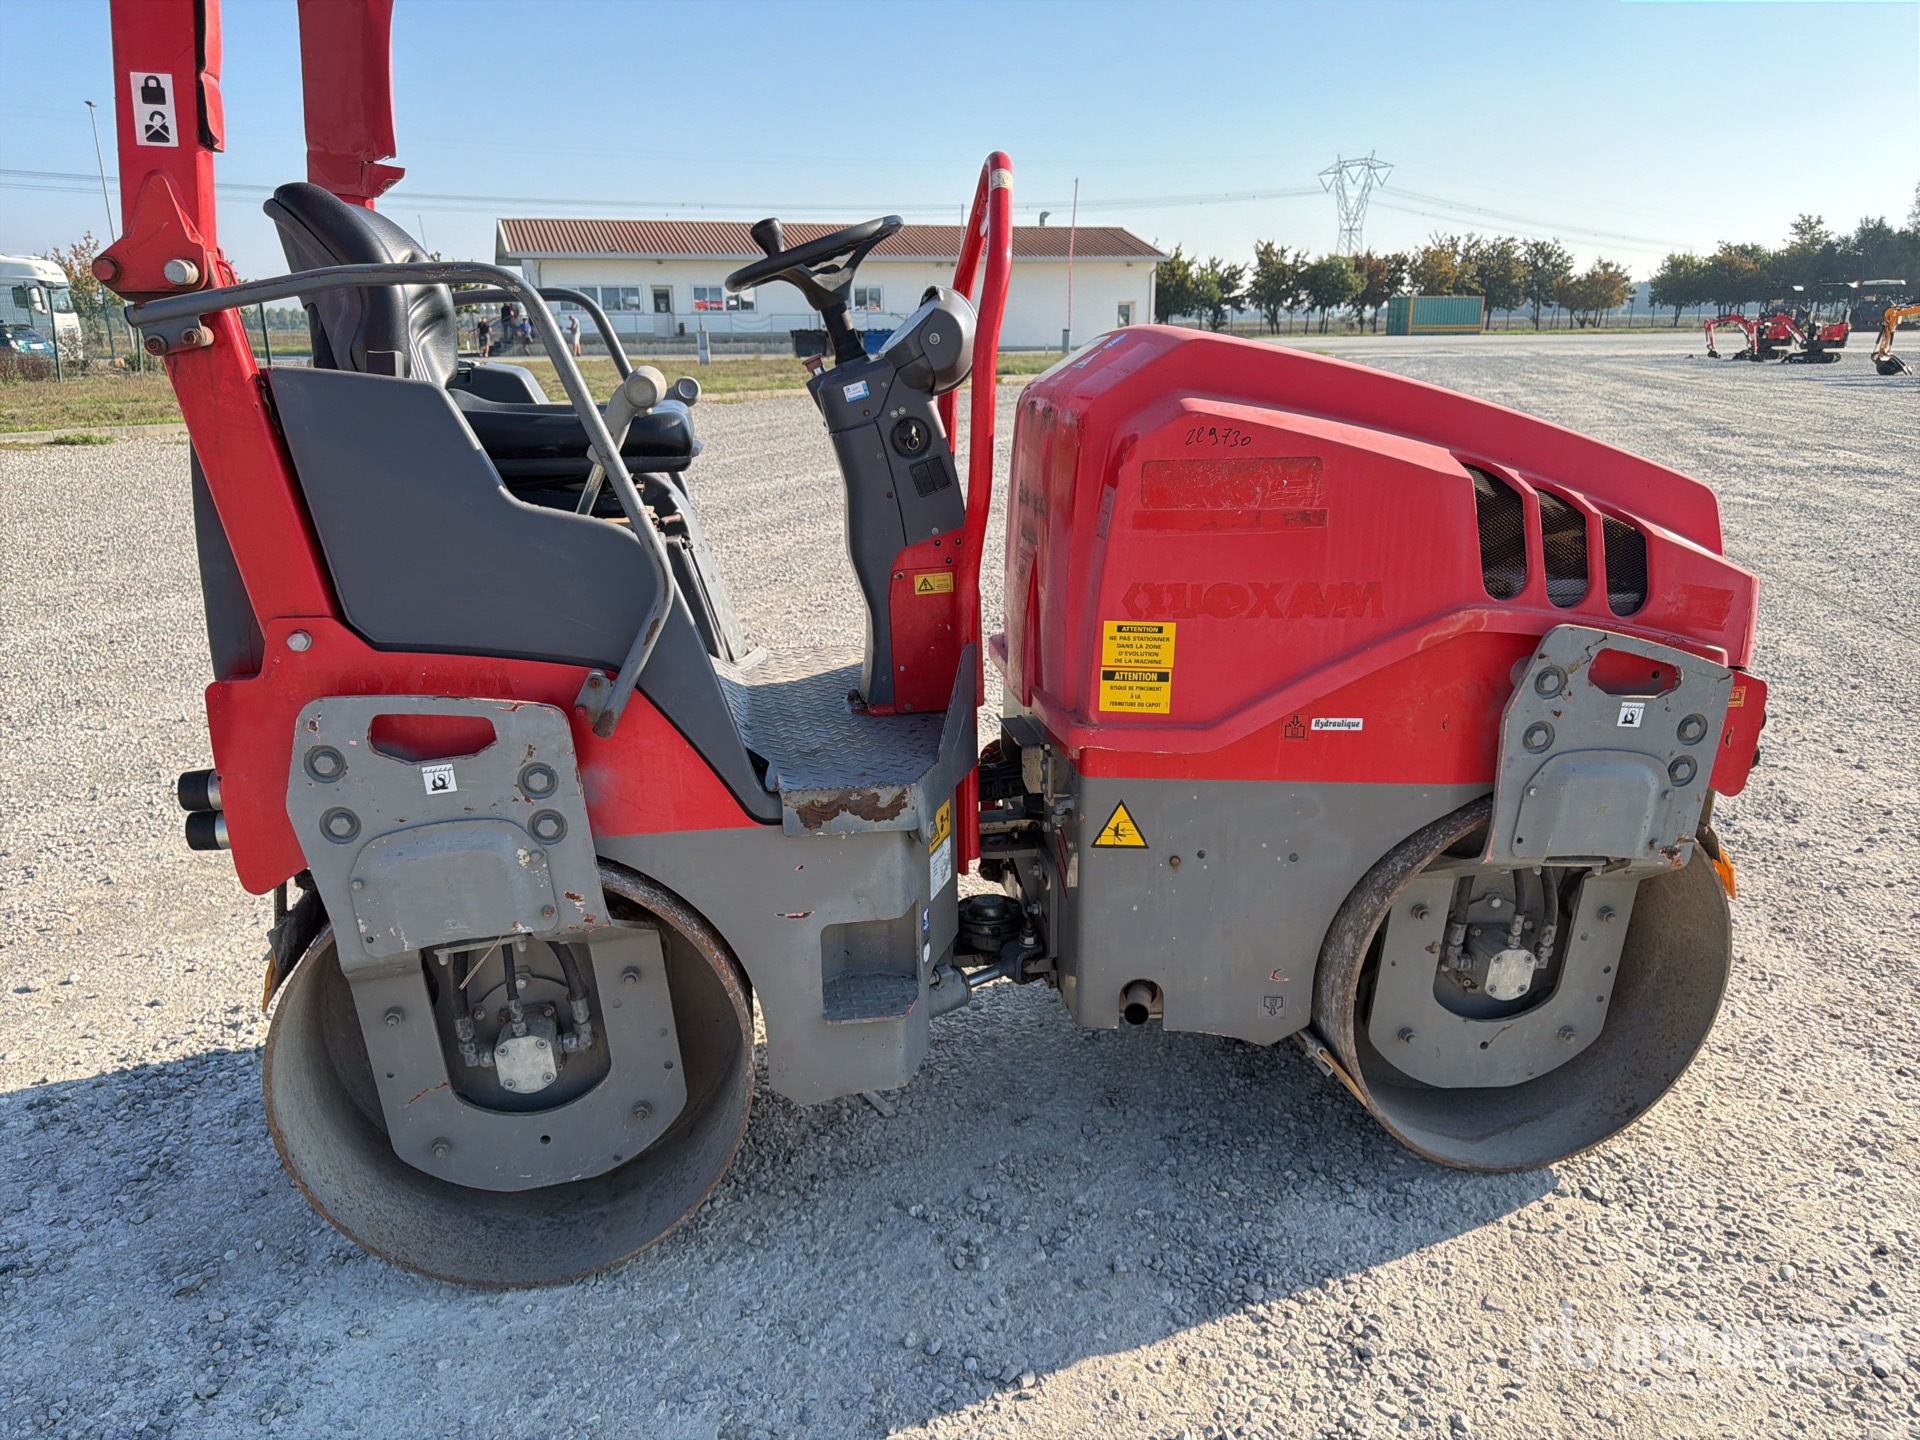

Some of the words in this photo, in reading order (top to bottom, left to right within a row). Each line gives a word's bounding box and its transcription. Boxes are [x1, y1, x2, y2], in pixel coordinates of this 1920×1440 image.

[1185, 427, 1252, 448] 229730
[1114, 672, 1158, 682] ATTENTION
[1314, 719, 1360, 729] Hydraulique
